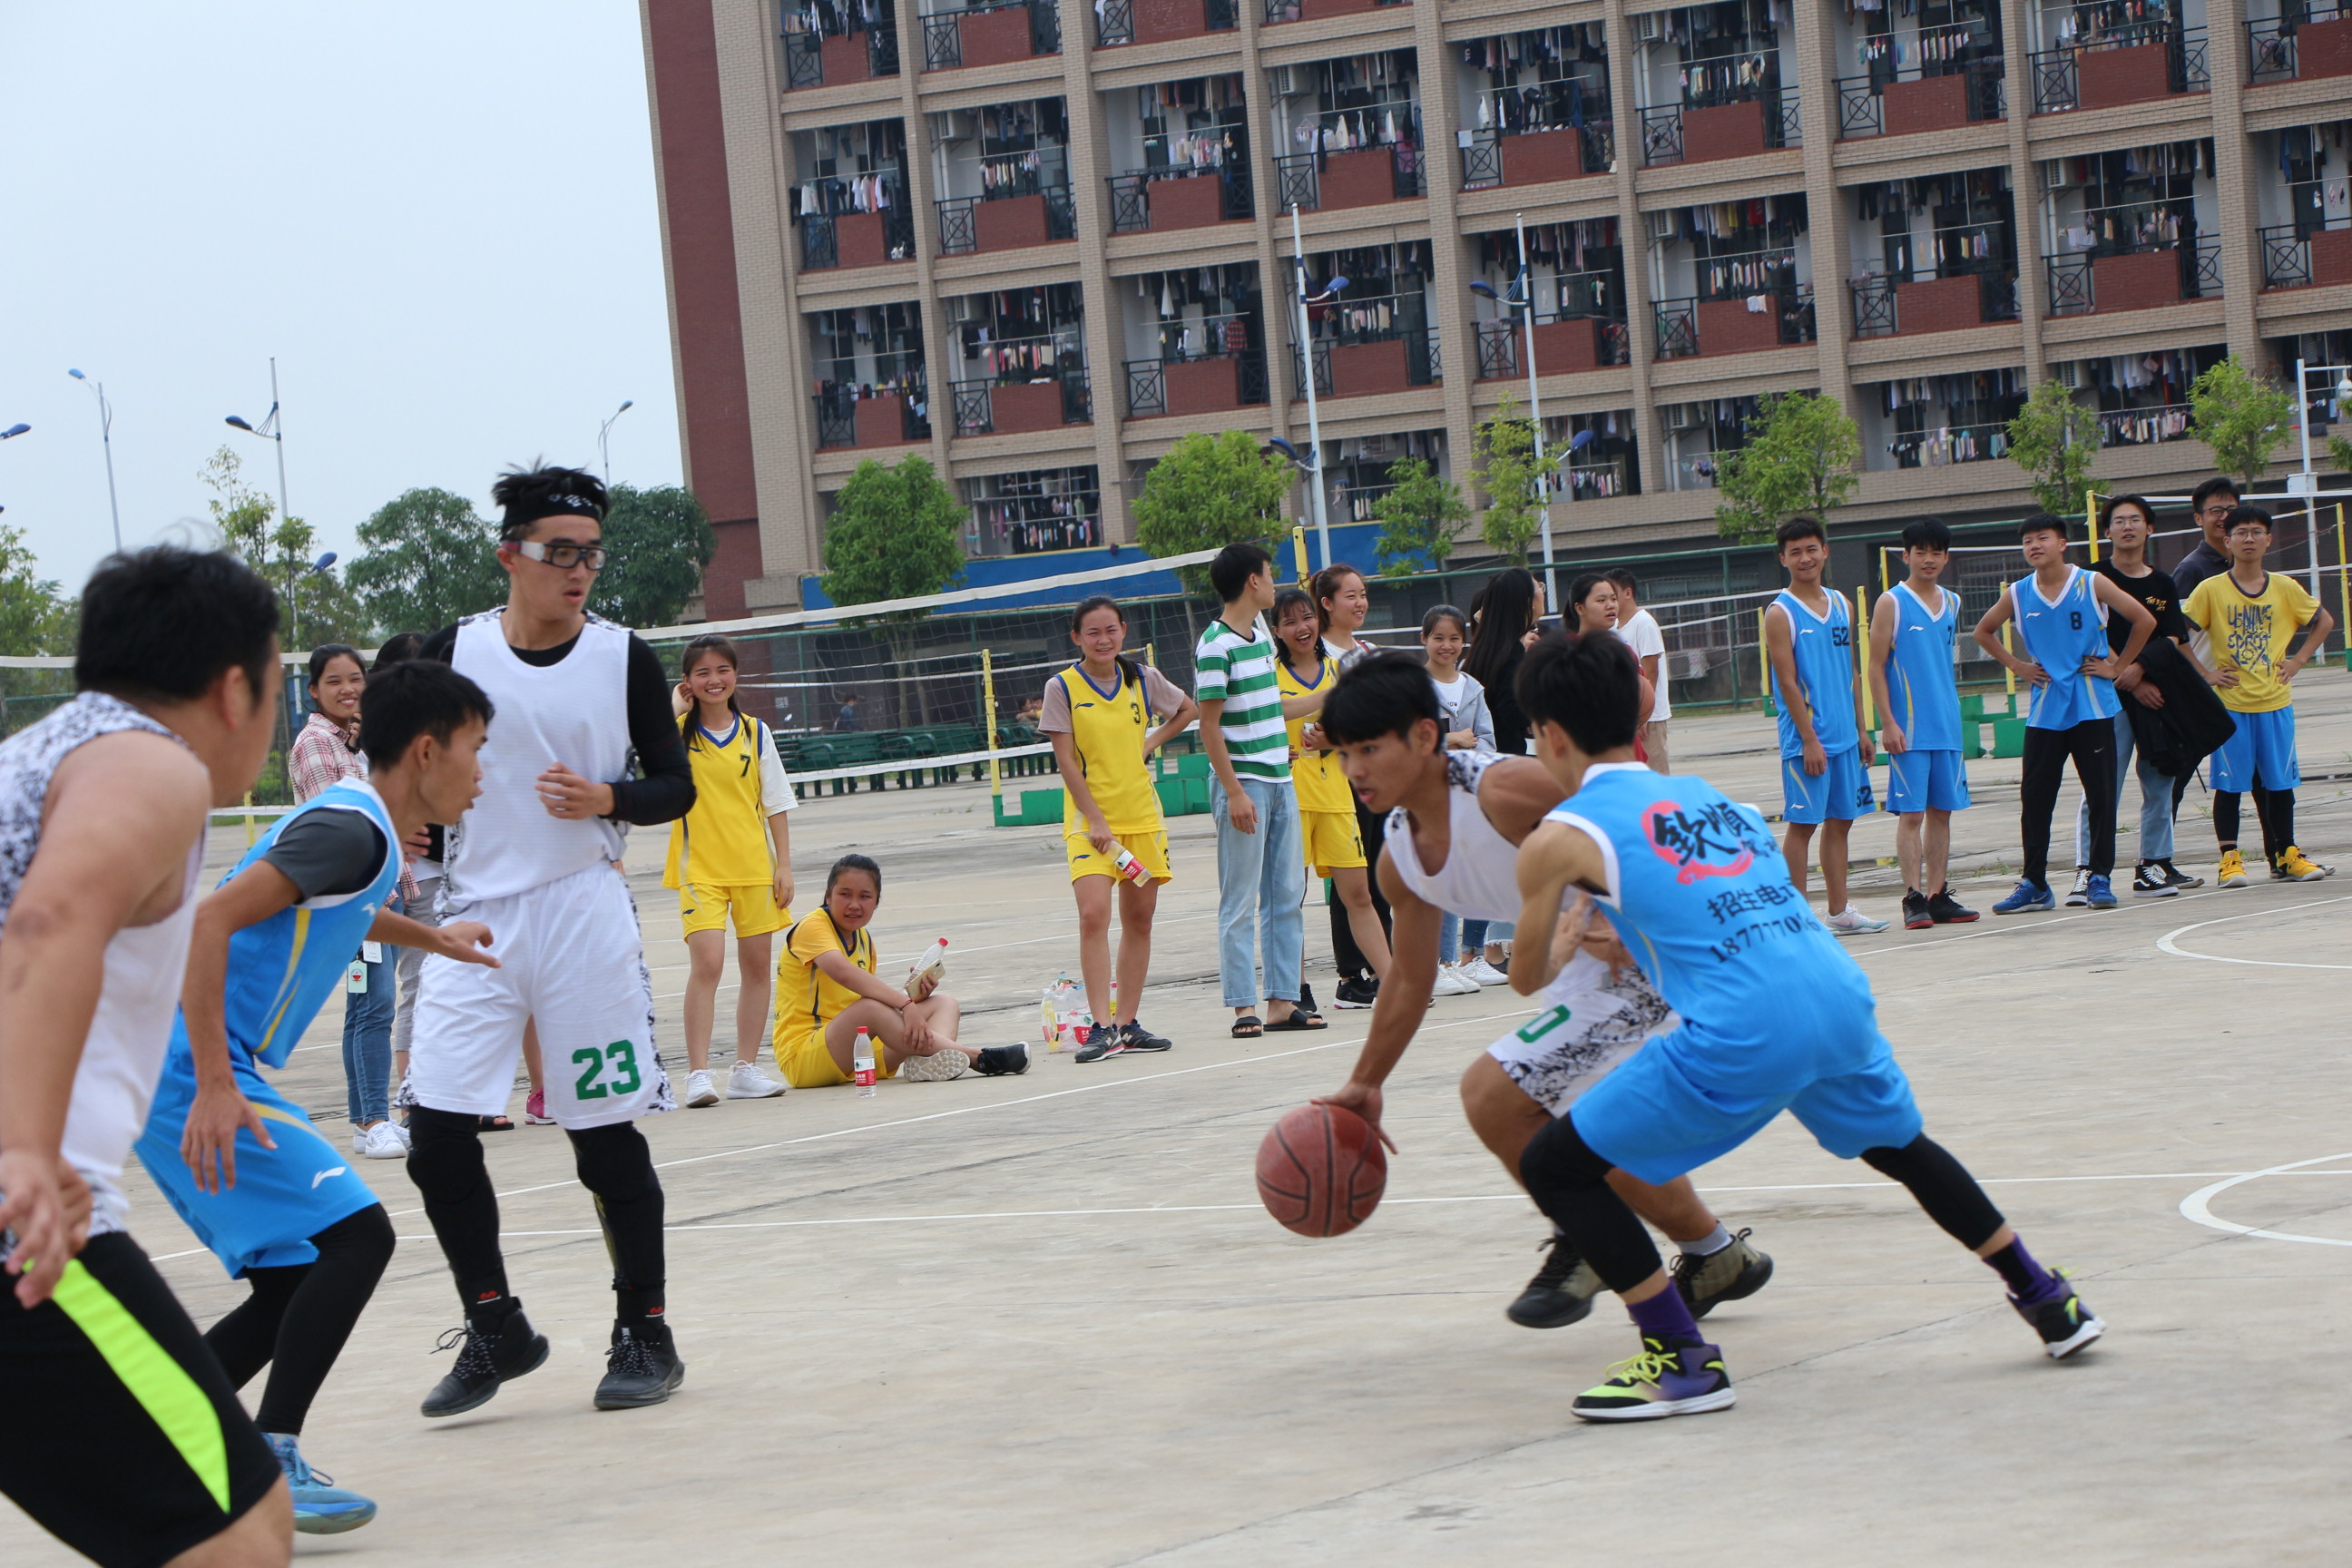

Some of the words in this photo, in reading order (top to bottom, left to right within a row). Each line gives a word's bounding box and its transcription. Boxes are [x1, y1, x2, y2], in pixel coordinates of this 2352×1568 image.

[2070, 611, 2083, 631] 8
[1831, 626, 1850, 646] 52
[1131, 702, 1141, 724] 3
[740, 753, 751, 778] 7
[571, 1039, 642, 1101] 23
